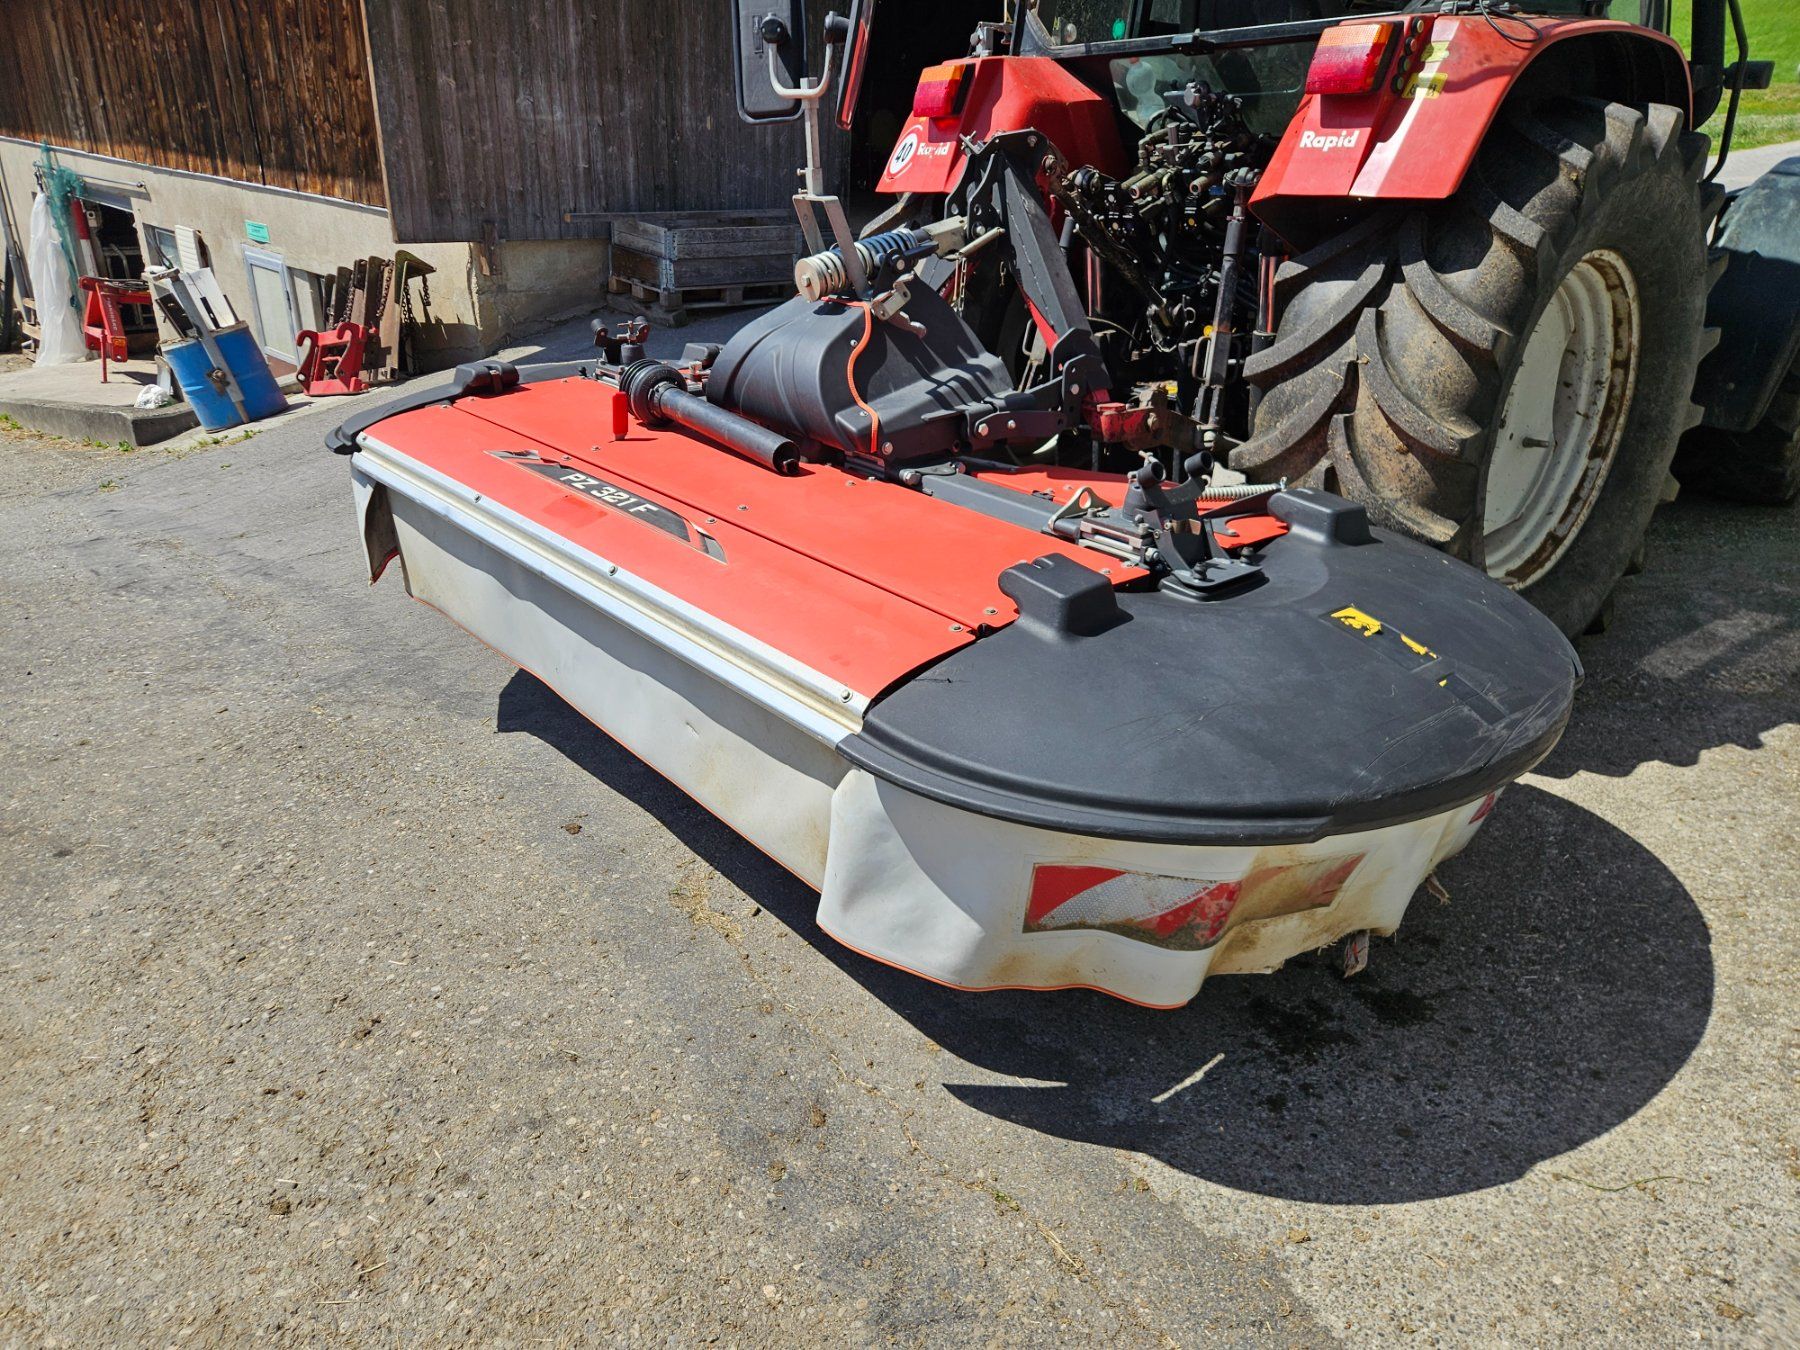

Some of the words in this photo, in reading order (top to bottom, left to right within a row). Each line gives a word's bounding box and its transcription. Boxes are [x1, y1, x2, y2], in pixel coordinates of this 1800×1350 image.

[1299, 130, 1360, 152] Rapid
[895, 142, 914, 163] 40
[560, 472, 599, 490] PZ
[590, 486, 639, 507] 321
[628, 503, 660, 513] F
